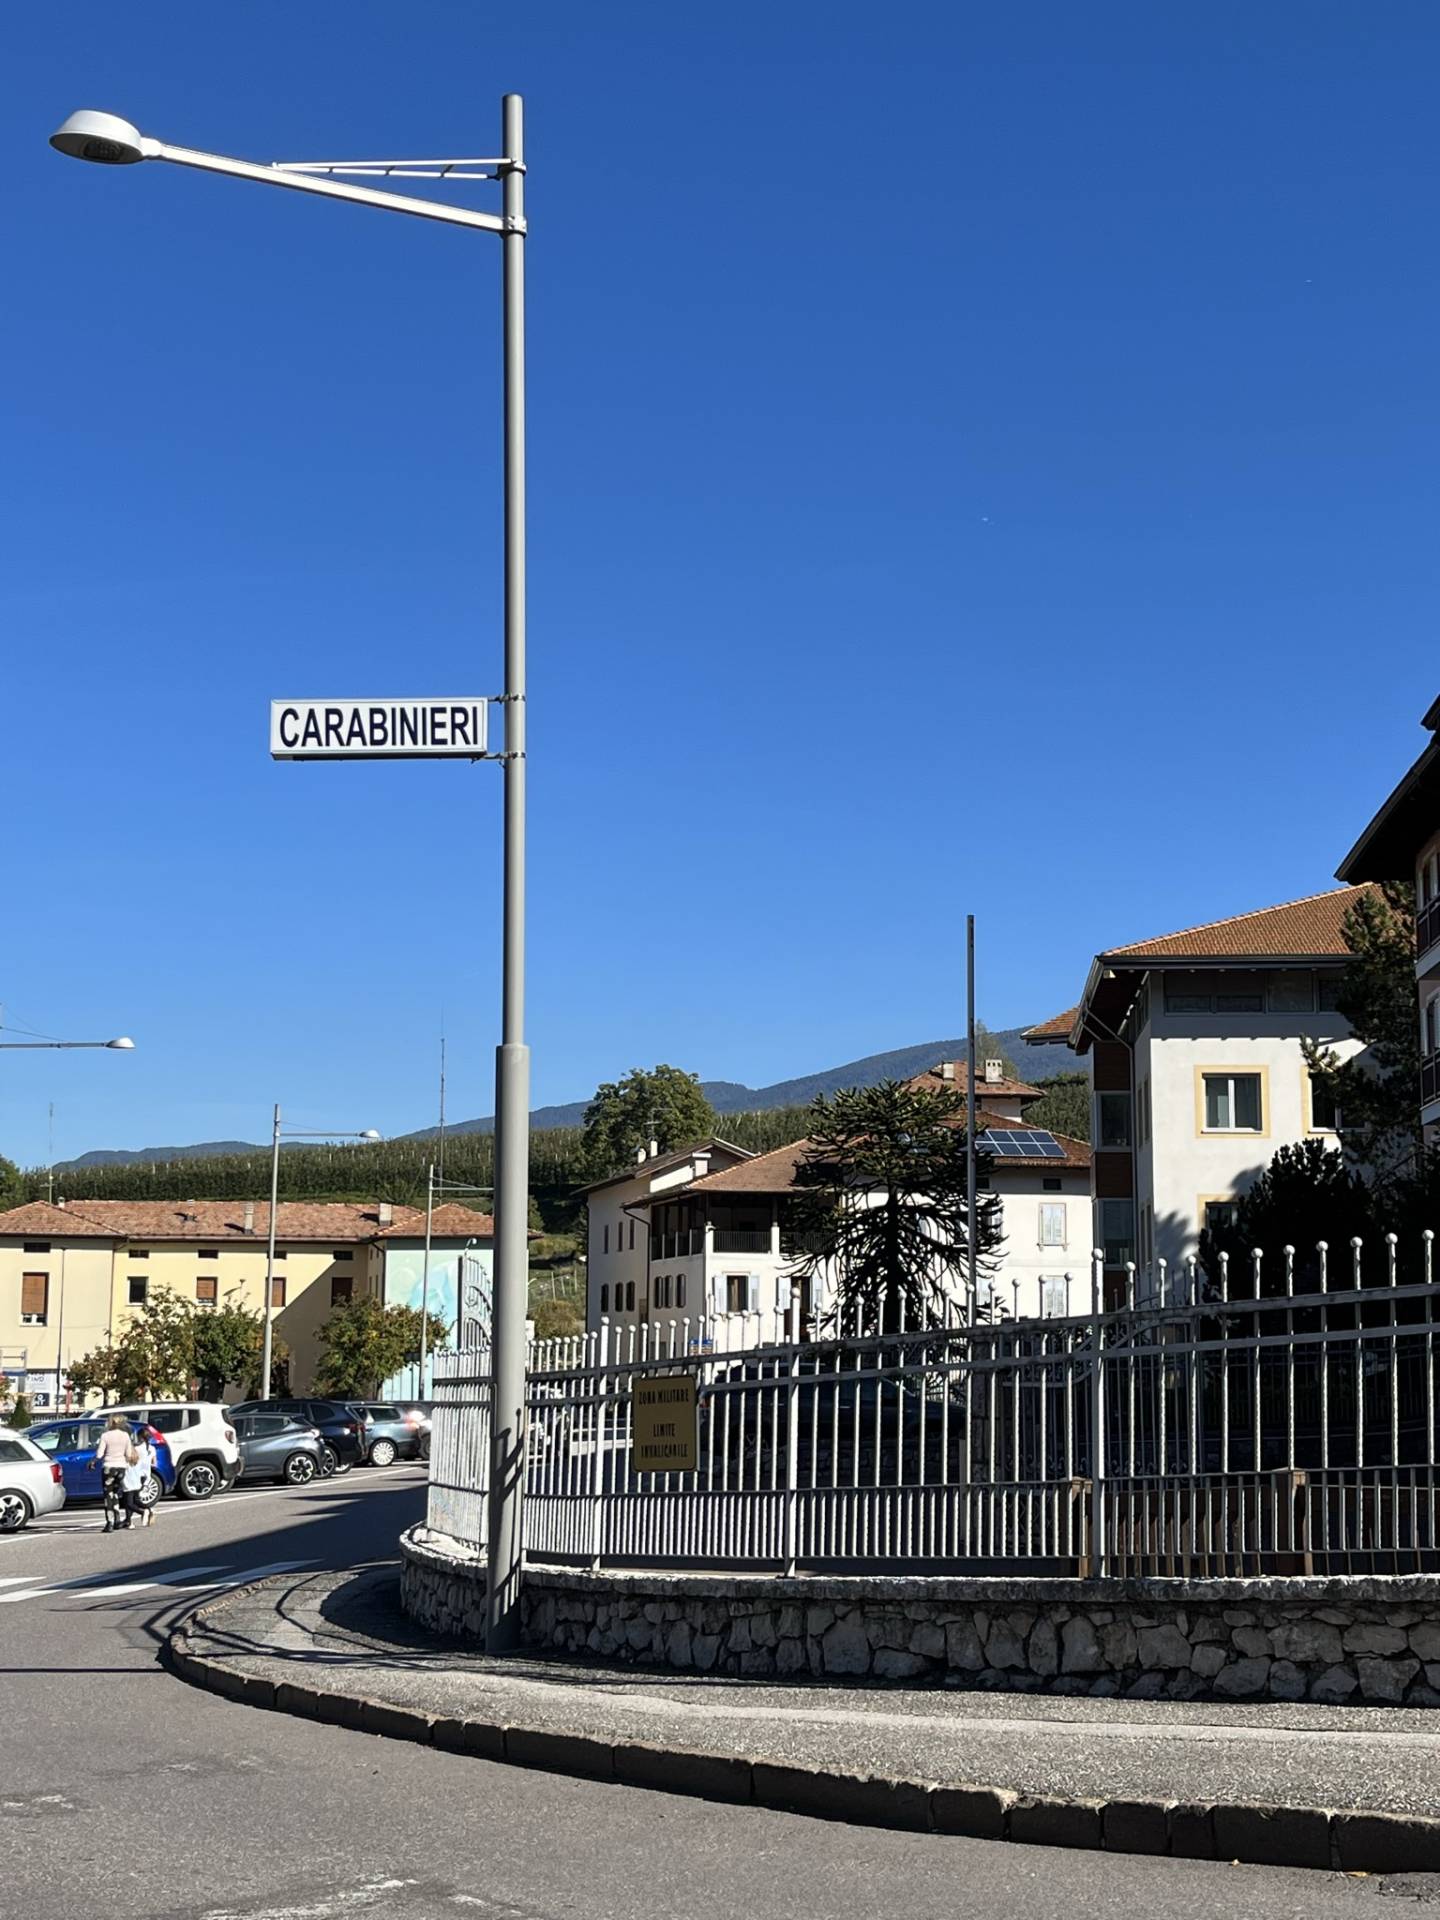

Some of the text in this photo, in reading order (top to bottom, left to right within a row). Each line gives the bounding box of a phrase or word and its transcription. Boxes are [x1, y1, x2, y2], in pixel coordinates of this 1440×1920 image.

[280, 706, 478, 747] CARABINIERI
[638, 1388, 689, 1405] ZONA MILITARE
[653, 1423, 676, 1437] LIMITE
